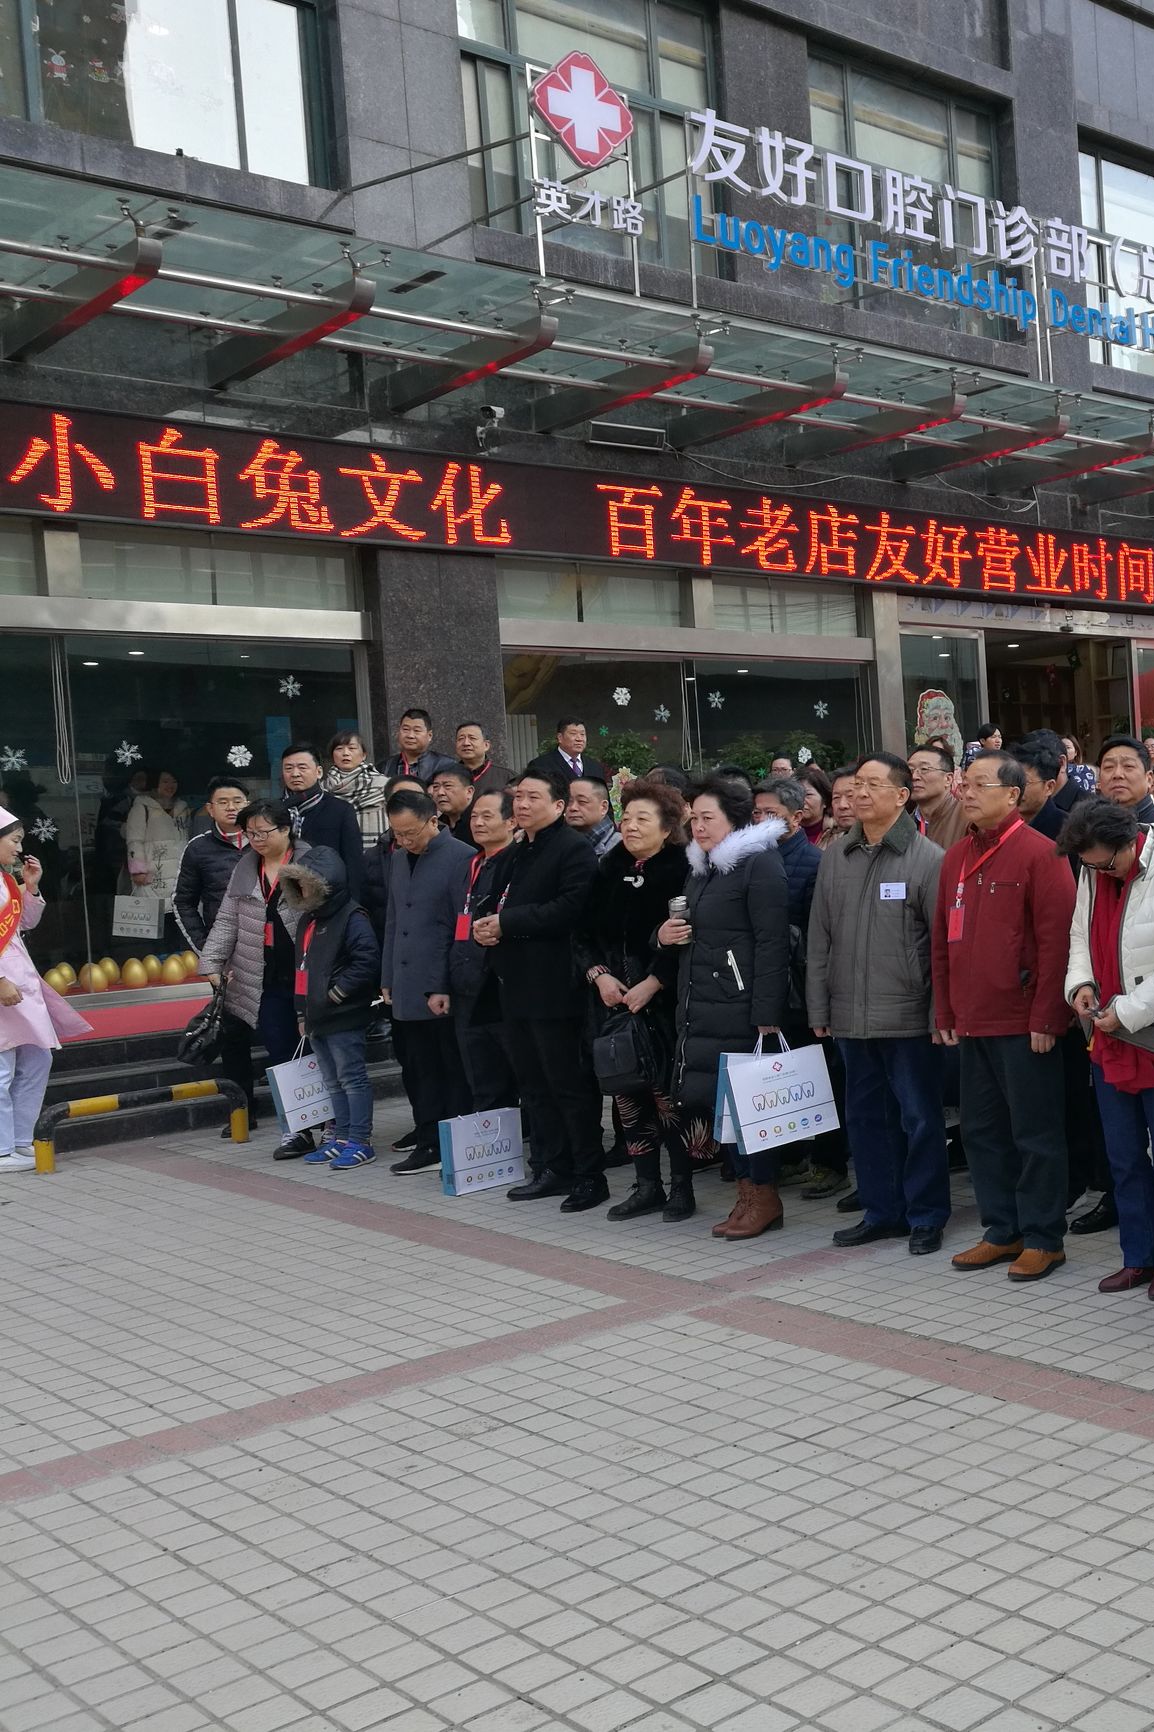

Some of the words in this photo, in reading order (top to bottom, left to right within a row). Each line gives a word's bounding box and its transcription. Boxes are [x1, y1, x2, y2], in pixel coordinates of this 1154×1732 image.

[533, 177, 645, 237] 英才路
[690, 194, 856, 289] Luoyang
[866, 240, 1037, 331] Friendship
[1047, 287, 1136, 346] Dental
[9, 413, 512, 547] 小白兔文化
